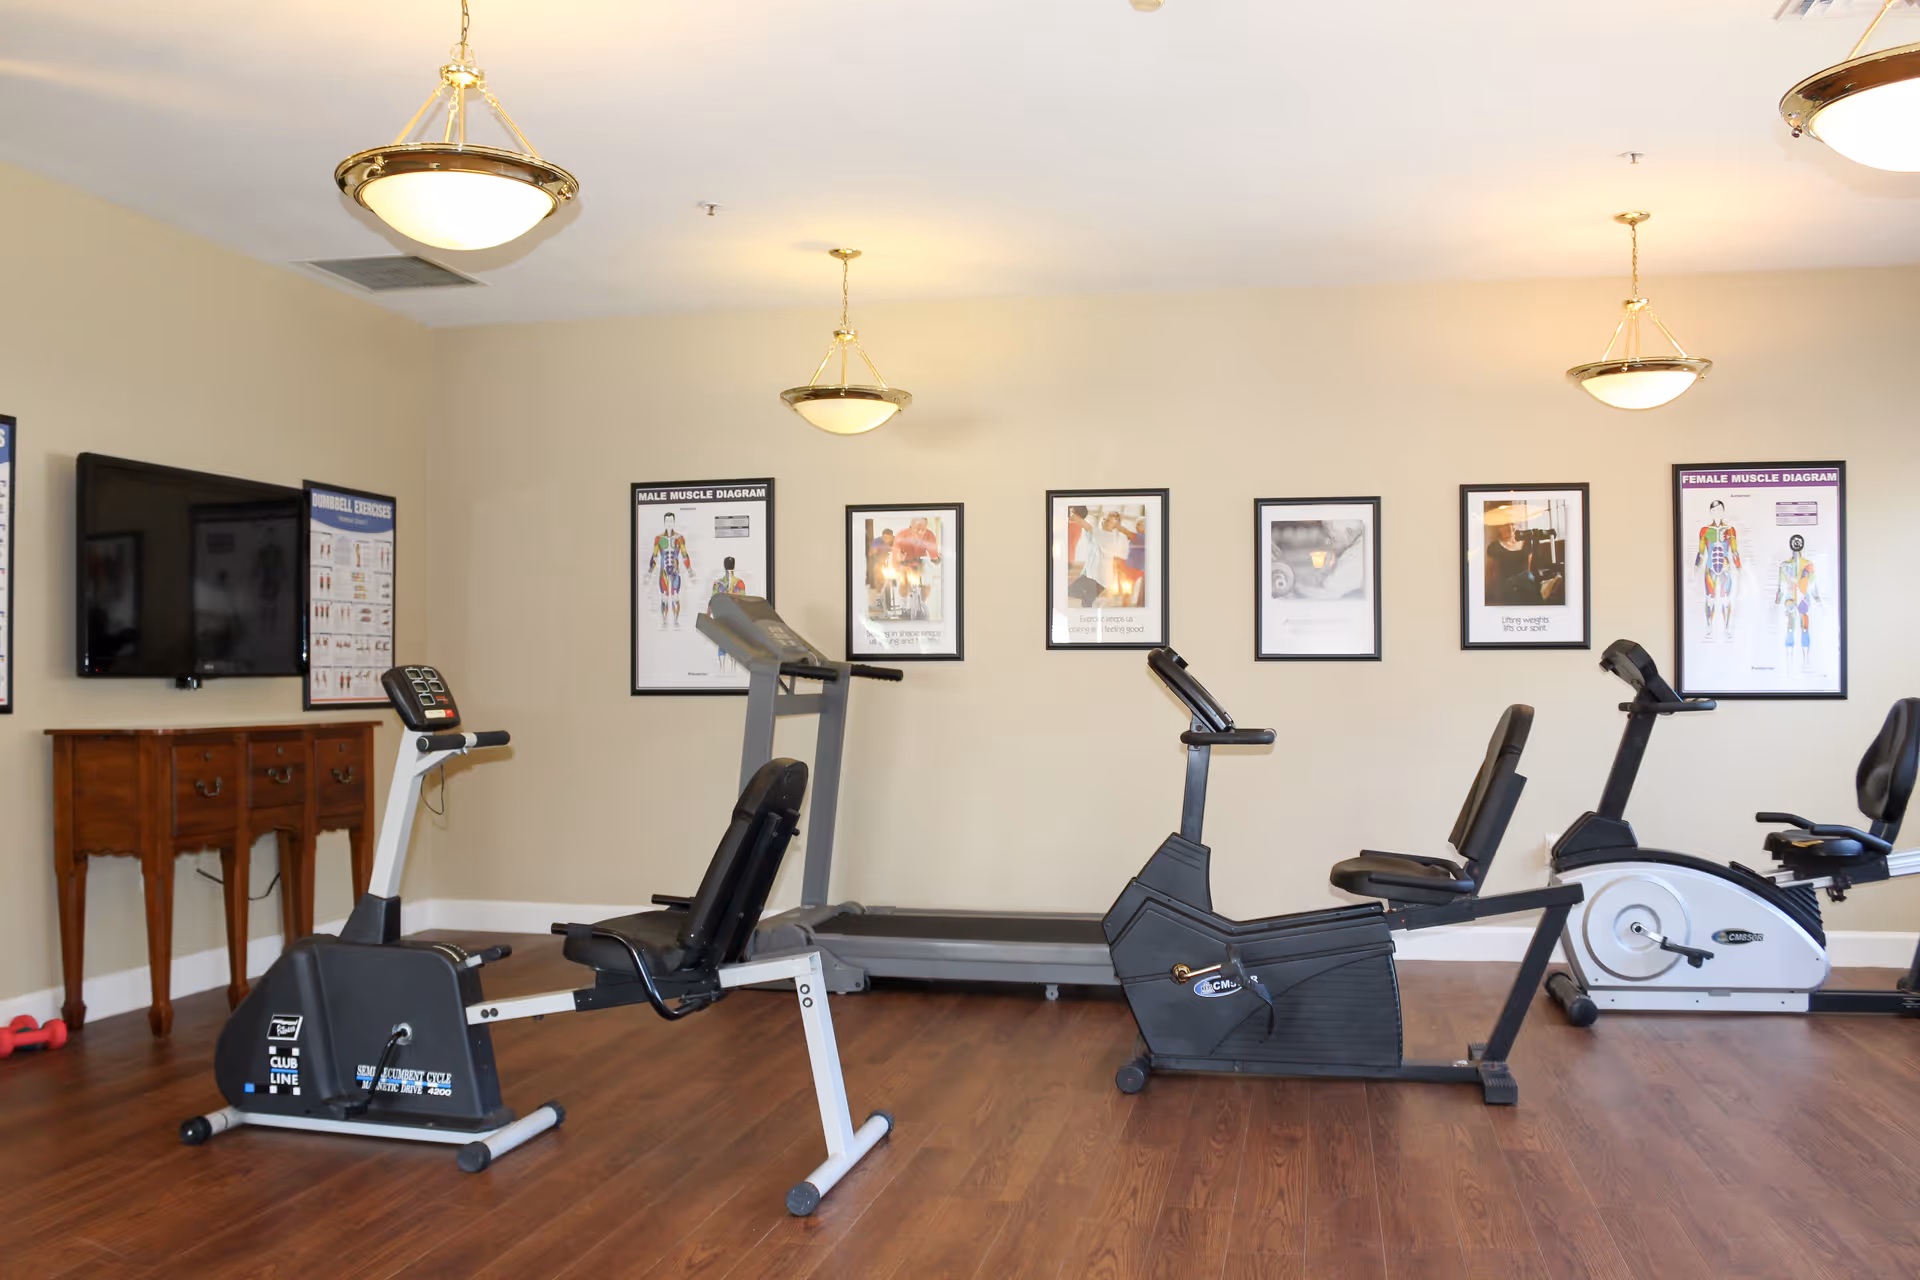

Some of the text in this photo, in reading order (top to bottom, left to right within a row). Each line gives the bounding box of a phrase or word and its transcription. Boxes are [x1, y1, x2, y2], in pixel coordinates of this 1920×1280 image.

[1682, 472, 1837, 484] FEMALE MUSCLE DIAGRAM
[638, 488, 766, 502] MALE MUSCLE DIAGRAM
[312, 492, 392, 519] DUMBBELL EXERCISES
[1501, 616, 1550, 625] Lifting weights
[1104, 625, 1125, 635] feeling
[1503, 624, 1515, 632] lifts
[269, 1056, 299, 1069] CLUB
[270, 1072, 299, 1086] LINE
[381, 1066, 425, 1082] ECUMBENT
[426, 1071, 452, 1085] CYCLE
[400, 1084, 424, 1095] DRIVE
[427, 1087, 453, 1097] 4200
